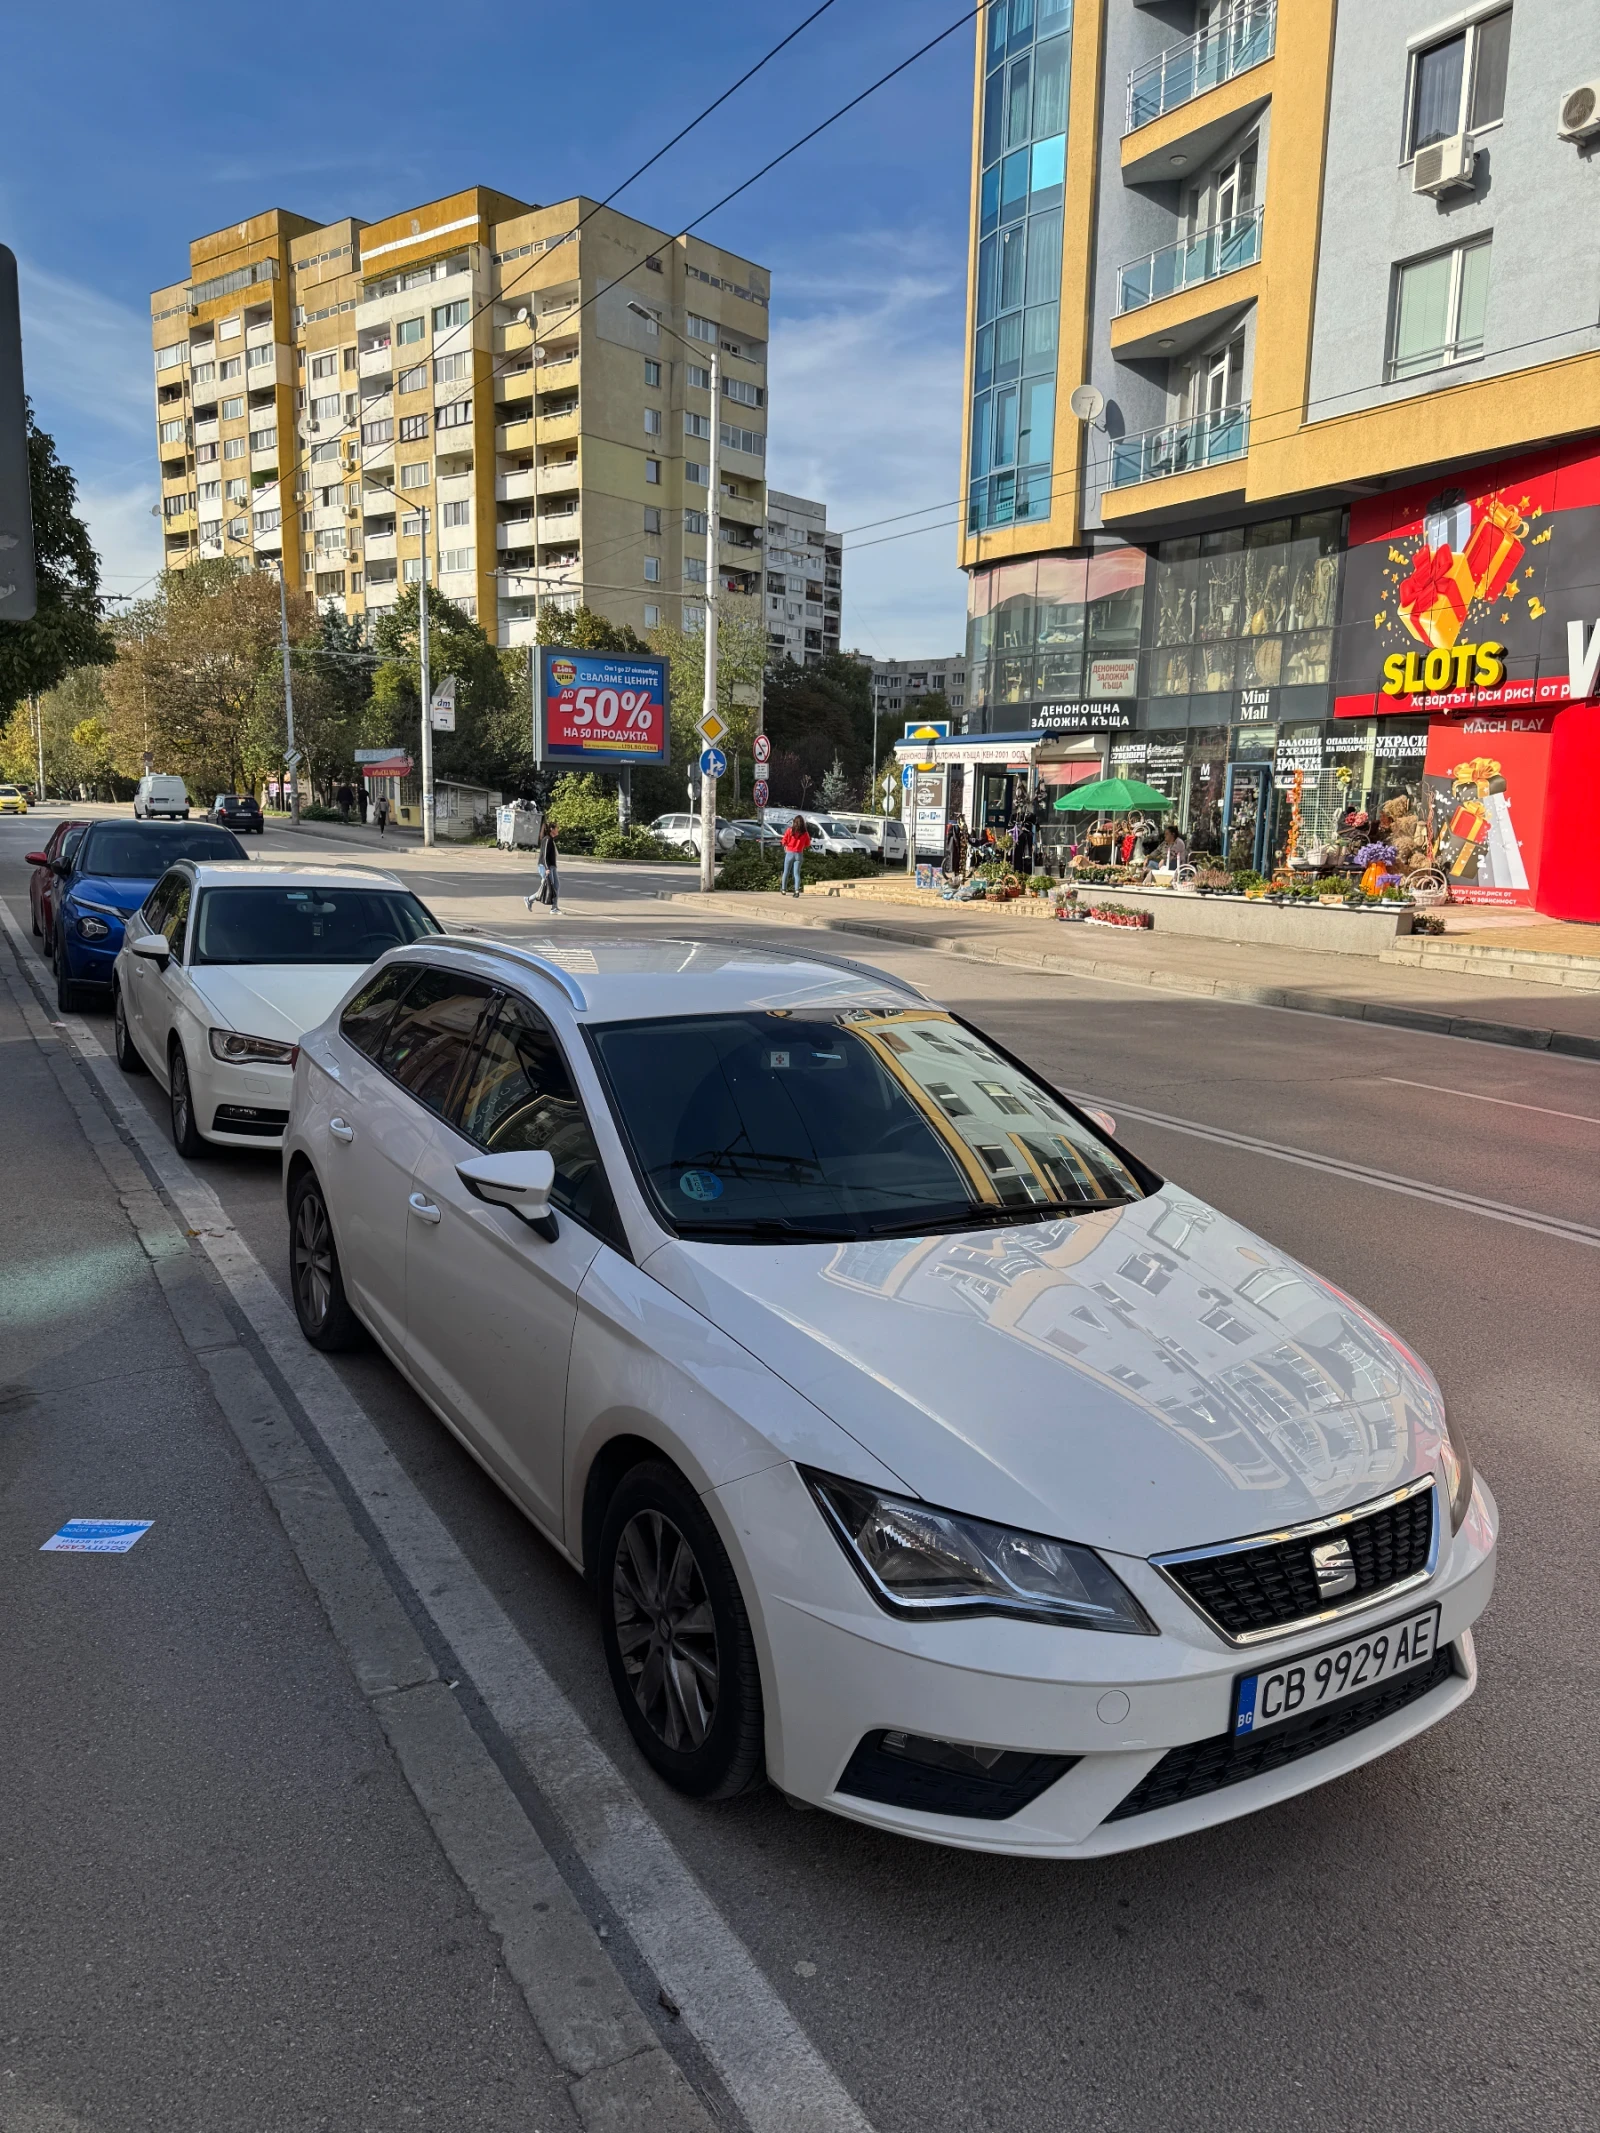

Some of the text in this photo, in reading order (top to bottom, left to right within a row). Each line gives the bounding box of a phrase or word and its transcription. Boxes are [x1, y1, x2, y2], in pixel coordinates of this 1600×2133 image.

[617, 666, 625, 674] до
[631, 668, 659, 676] октомври
[1092, 663, 1135, 674] ДЕНОНОЩНА
[1382, 641, 1504, 695] SLOTS
[580, 672, 659, 687] СВАЛЯМЕ ЦЕНИТЕ
[1097, 672, 1129, 682] ЗАЛОЖНА
[1102, 681, 1123, 690] КЪЩА
[1540, 684, 1558, 696] от
[561, 690, 574, 699] ДО
[1240, 689, 1270, 705] Mini
[437, 699, 451, 707] dm
[560, 689, 653, 729] -50%
[1040, 703, 1120, 717] ДЕНОНОЩНА
[1240, 705, 1268, 720] Mall
[1031, 716, 1130, 728] ЗАЛОЖНА КЪЩА
[1463, 718, 1545, 734] MATCH PLAY
[563, 727, 648, 741] НА 50 ПРОДУКТА
[1278, 738, 1322, 747] БАЛОНИ
[1325, 736, 1375, 745] ОПАКОВАНЕ
[1376, 735, 1428, 748] УКРАСИ
[935, 752, 961, 760] АЛОЖНА
[962, 750, 981, 760] КЪЩА
[982, 750, 1009, 759] КЕН-2001
[1276, 745, 1323, 756] С ХЕЛИЙ
[1375, 746, 1427, 758] ПОД НАЕМ
[1276, 757, 1323, 766] ПАРТИ
[1261, 1616, 1432, 1719] CB 9929 AE
[1237, 1711, 1253, 1728] BG
